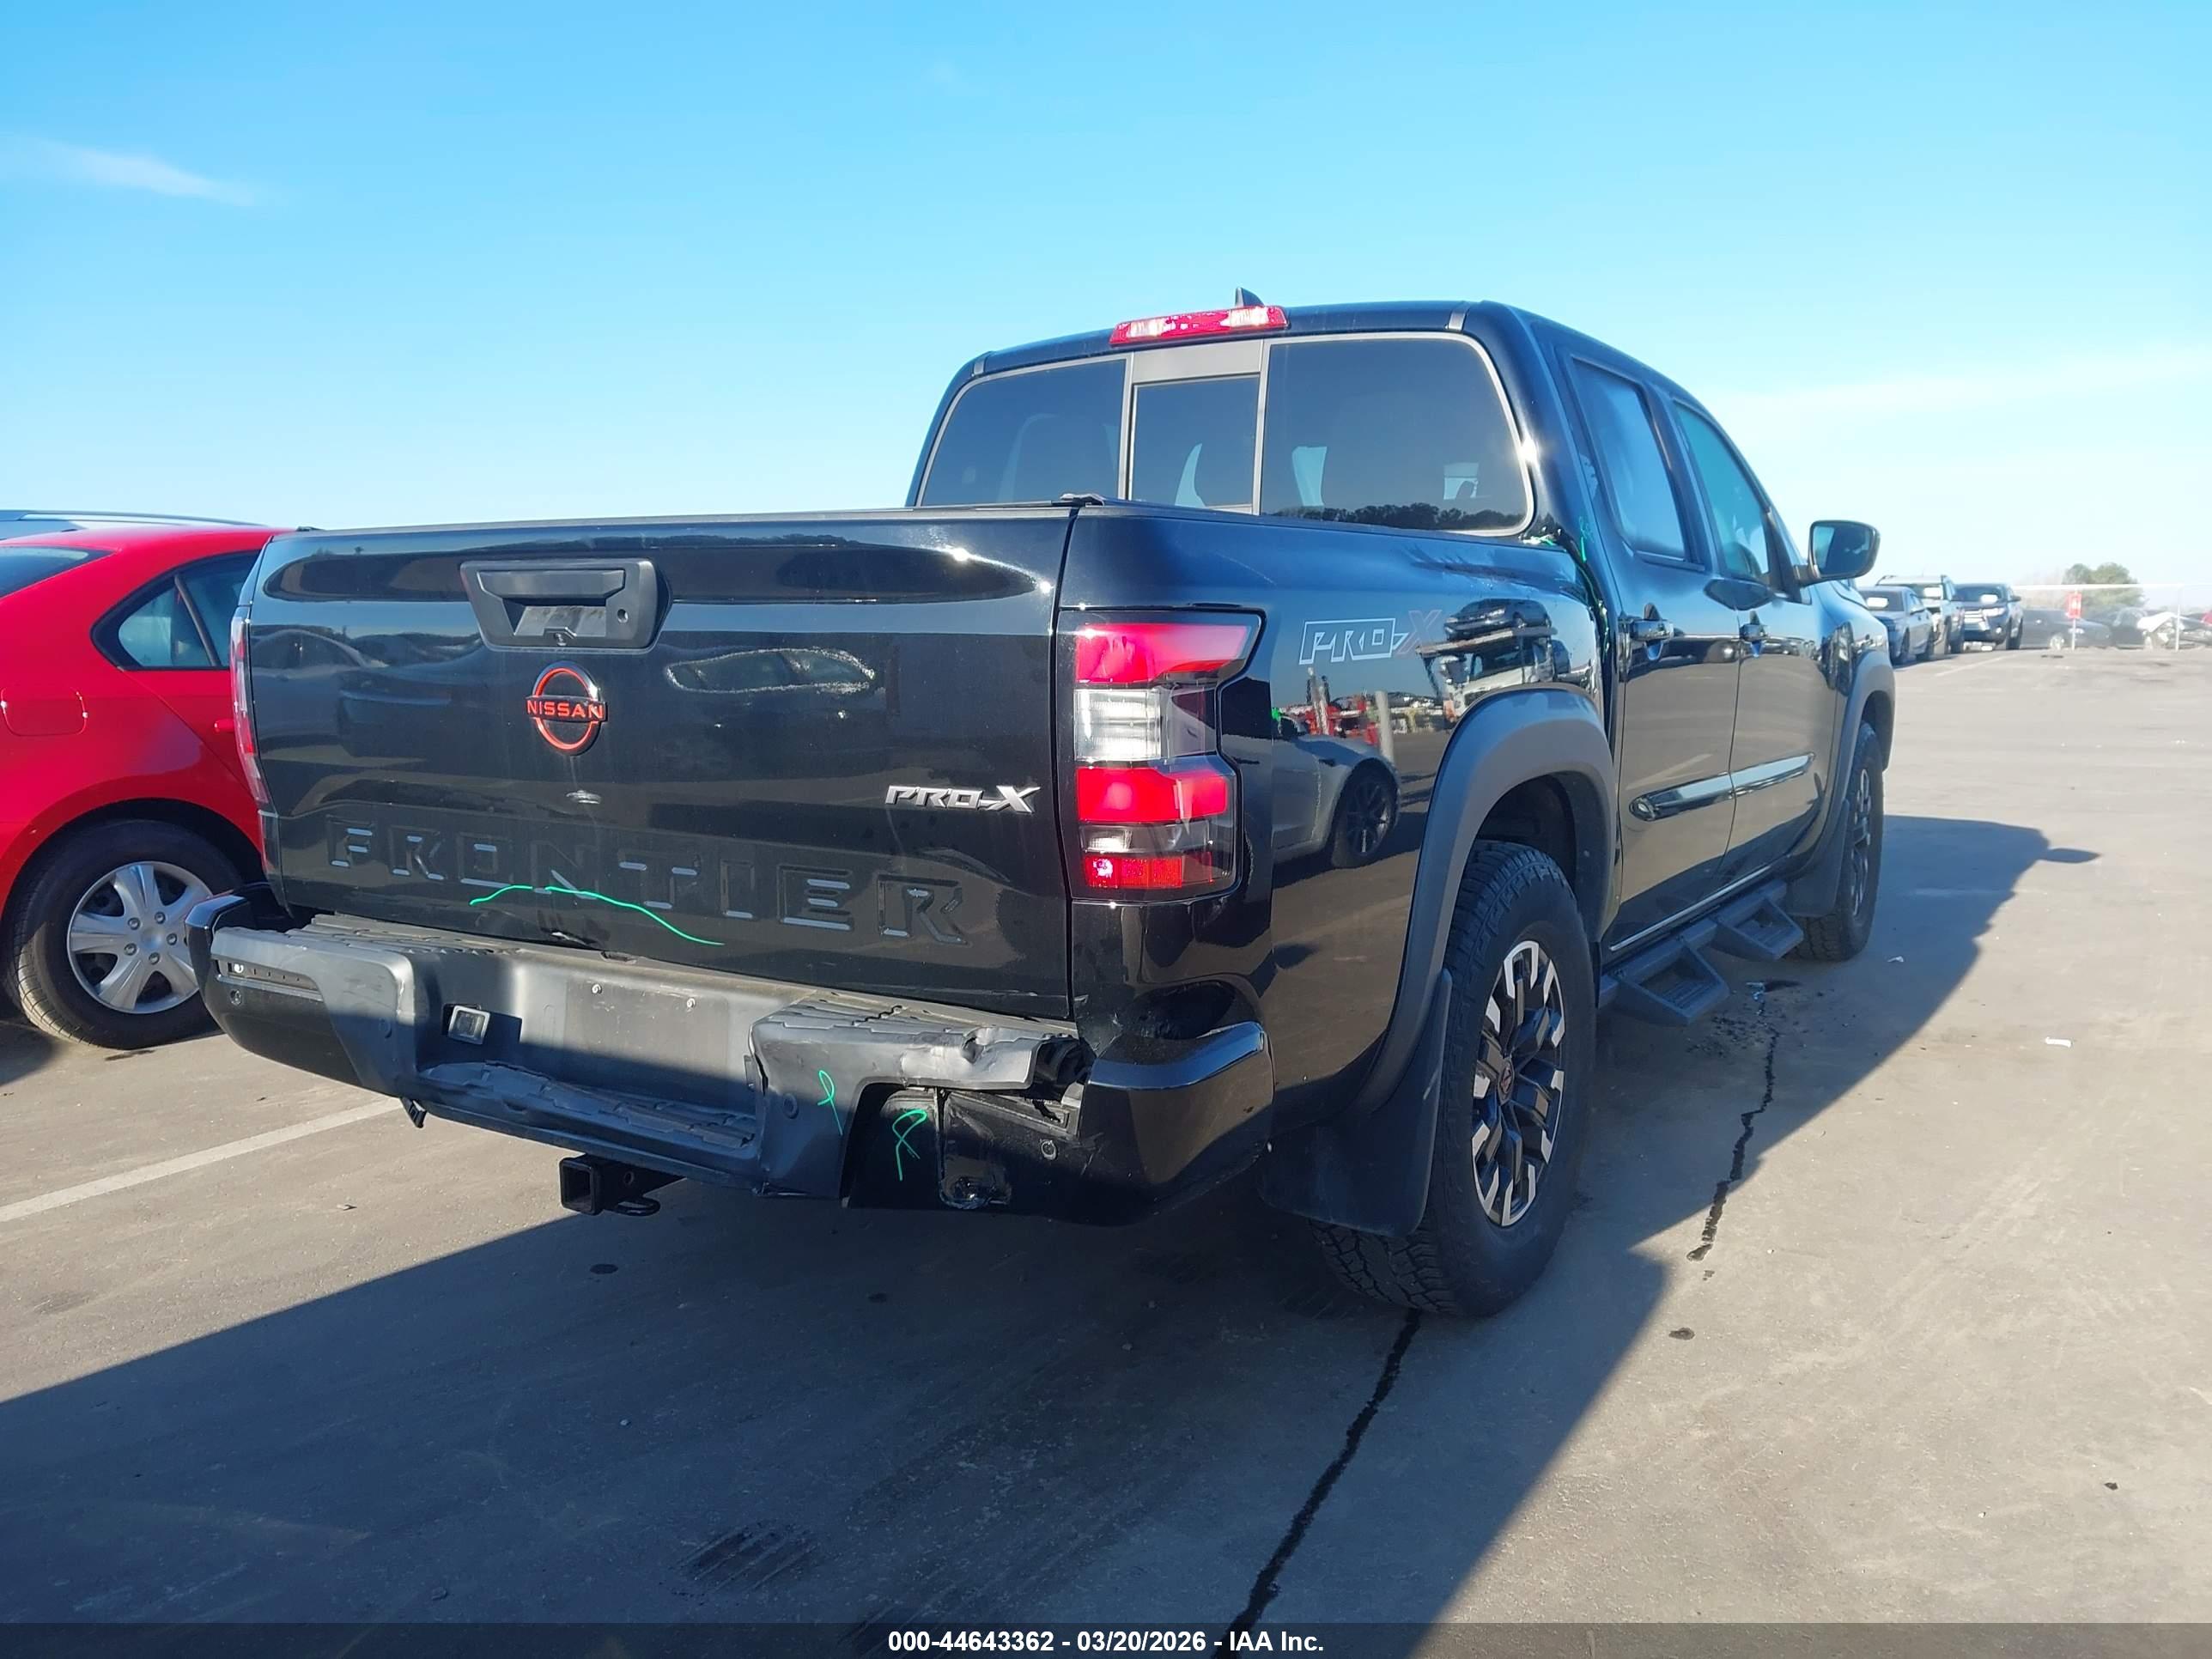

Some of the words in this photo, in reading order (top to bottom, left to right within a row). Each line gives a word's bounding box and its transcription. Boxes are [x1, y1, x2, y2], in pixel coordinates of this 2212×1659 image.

[526, 699, 606, 721] NISSAN
[884, 784, 1041, 814] PRO-X
[325, 815, 970, 946] FRONTIER
